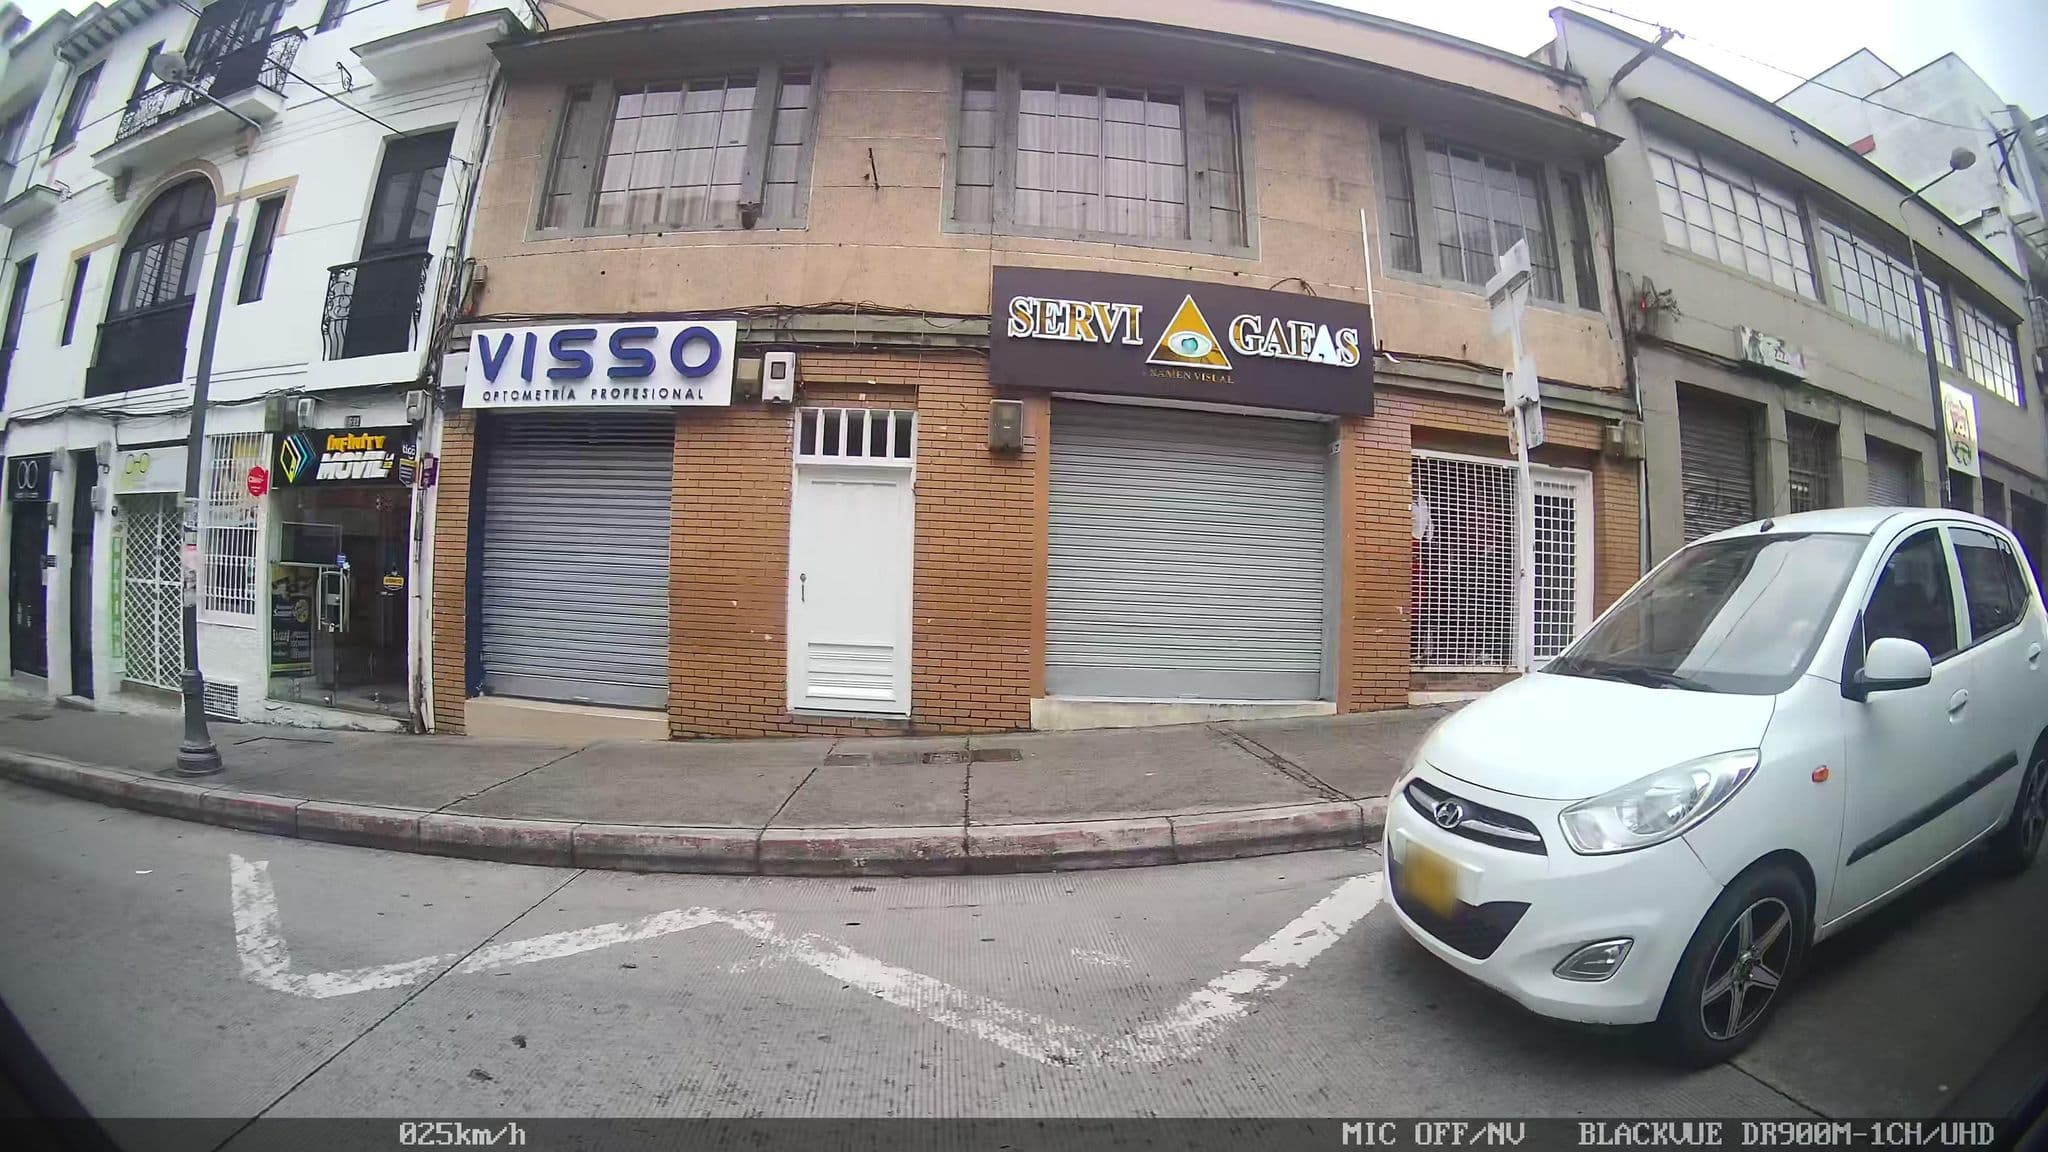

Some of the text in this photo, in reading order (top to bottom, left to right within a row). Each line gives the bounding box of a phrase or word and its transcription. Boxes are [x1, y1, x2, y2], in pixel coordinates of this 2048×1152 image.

[477, 325, 722, 383] VISSO
[1007, 295, 1361, 367] SERVI GAFAS
[591, 387, 704, 401] PROFESIONAL
